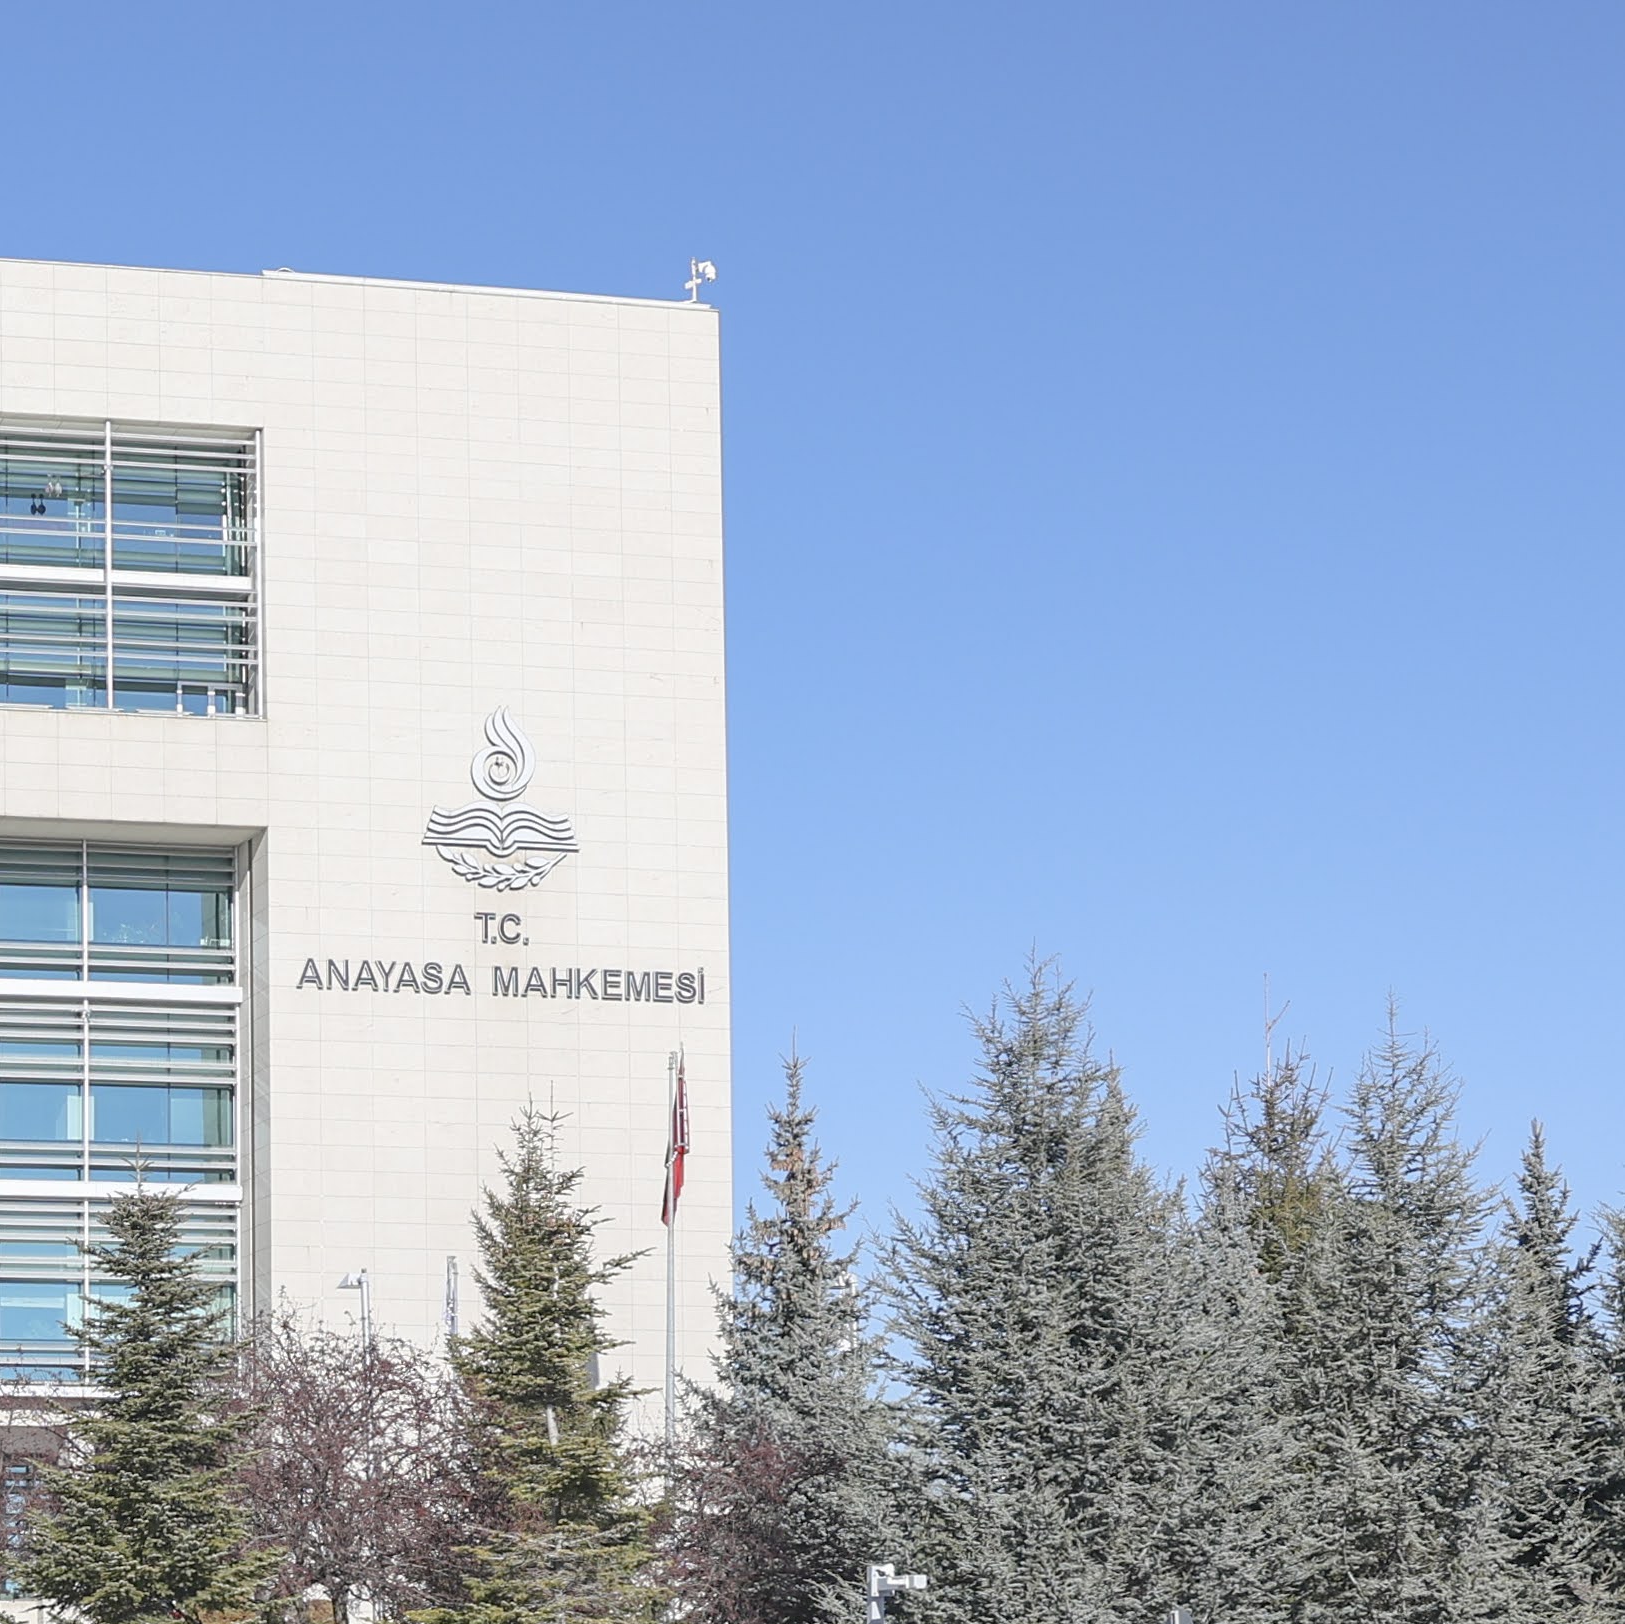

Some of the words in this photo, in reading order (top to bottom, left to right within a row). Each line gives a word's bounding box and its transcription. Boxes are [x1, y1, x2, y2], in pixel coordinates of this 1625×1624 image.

[473, 911, 530, 946] T.C.
[296, 957, 471, 996] ANAYASA
[491, 965, 706, 1005] MAHKEMESİ
